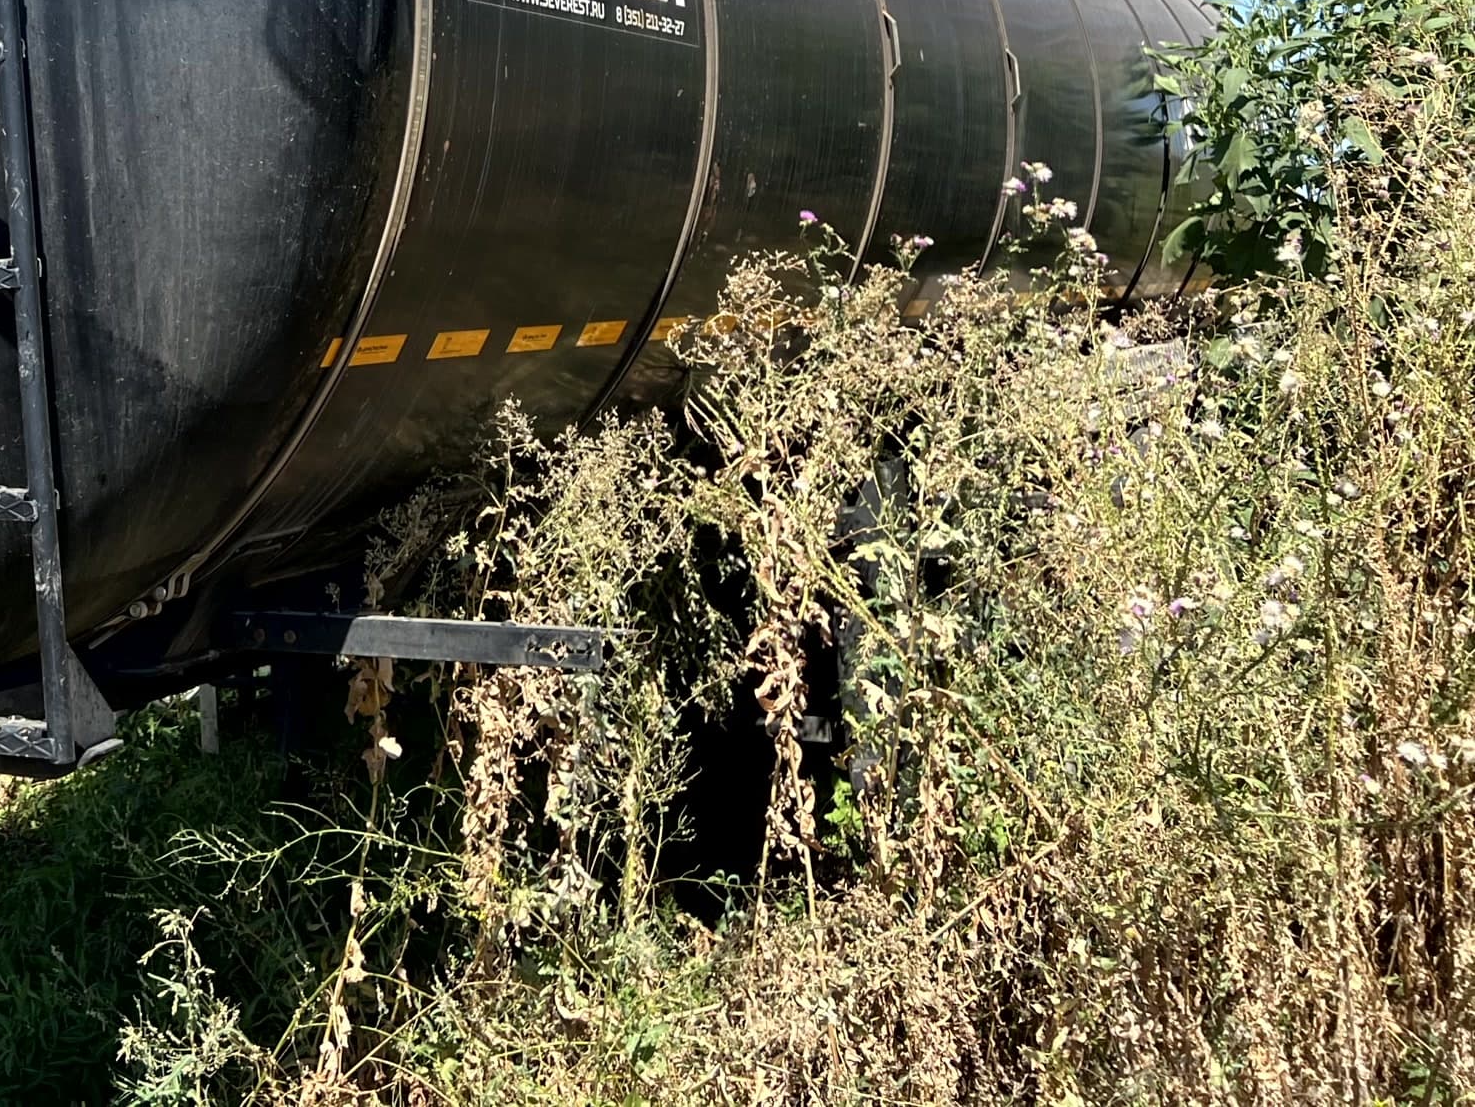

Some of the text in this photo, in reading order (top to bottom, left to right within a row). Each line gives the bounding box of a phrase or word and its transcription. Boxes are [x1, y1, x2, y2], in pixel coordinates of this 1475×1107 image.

[616, 6, 622, 23] 8
[624, 5, 644, 29] (351)
[646, 13, 685, 36] 211-32-27
